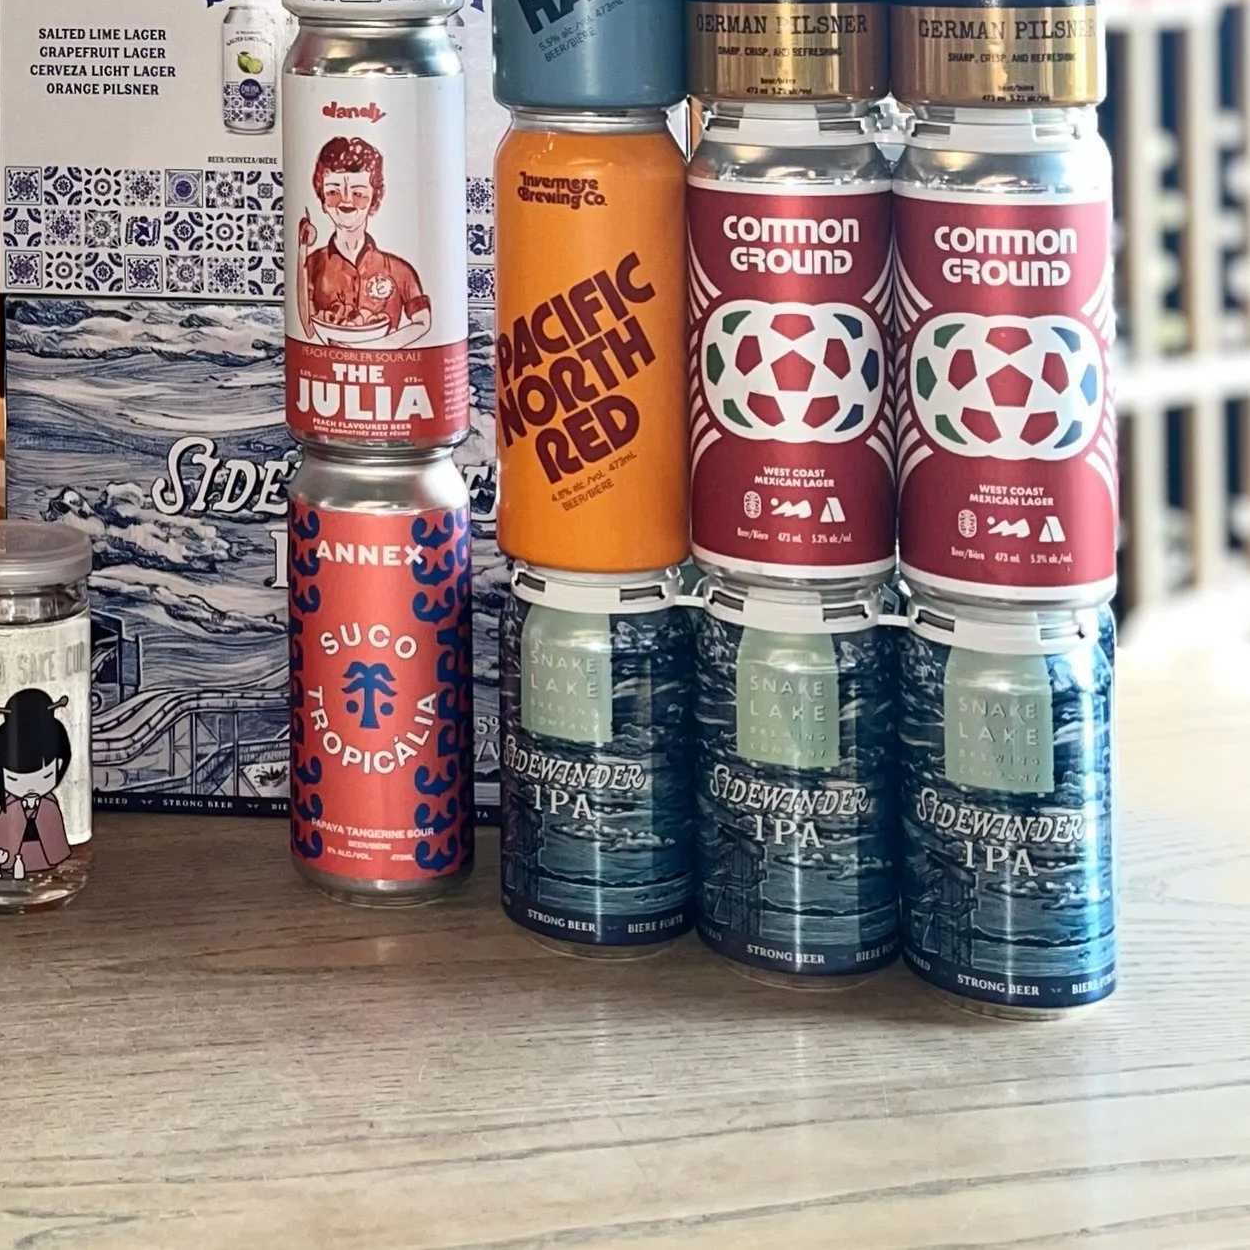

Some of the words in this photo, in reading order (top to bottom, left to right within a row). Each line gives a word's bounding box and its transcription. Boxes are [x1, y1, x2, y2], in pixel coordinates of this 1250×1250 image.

[38, 28, 86, 41] SALTED
[89, 28, 122, 40] LIME
[123, 28, 167, 41] LAGER
[696, 14, 767, 34] GERMAN
[776, 12, 868, 33] PILSNER
[39, 46, 122, 59] GRAPEFRUIT
[123, 46, 166, 59] LAGER
[29, 65, 88, 77] CERVEZA
[91, 65, 131, 78] LIGHT
[132, 65, 176, 78] LAGER
[46, 83, 100, 95] ORANGE
[103, 83, 159, 96] PILSNER
[322, 101, 386, 124] dandy
[519, 171, 599, 195] Invermere
[517, 188, 582, 210] Brewing
[497, 251, 656, 387] PACIFIC
[329, 351, 373, 363] COBBLER
[376, 352, 404, 362] SOUR
[332, 363, 385, 384] THE
[498, 315, 656, 447] NORTH
[296, 381, 436, 421] JULIA
[340, 420, 387, 430] FLAVOURED
[535, 393, 641, 485] RED
[754, 476, 802, 488] MEXICAN
[804, 478, 835, 488] LAGER
[763, 466, 793, 477] WEST
[795, 467, 826, 478] COAST
[316, 541, 424, 567] ANNEX
[319, 622, 418, 660] SUCO
[530, 679, 599, 699] LAKE
[957, 697, 1038, 726] SNAKE
[306, 685, 439, 774] TROPICÁLIA
[958, 721, 1039, 746] LAKE
[502, 735, 646, 791] SIDEWINDER
[709, 764, 870, 816] SIDEWINDER
[533, 784, 596, 821] IPA
[916, 788, 1085, 844] SIDEWINDER
[311, 818, 344, 835] PAPAYA
[346, 826, 405, 839] TANGERINE
[406, 827, 434, 838] SOUR
[754, 814, 825, 849] IPA
[963, 840, 1038, 877] IPA
[527, 910, 565, 930] STRONG
[747, 944, 792, 962] STRONG
